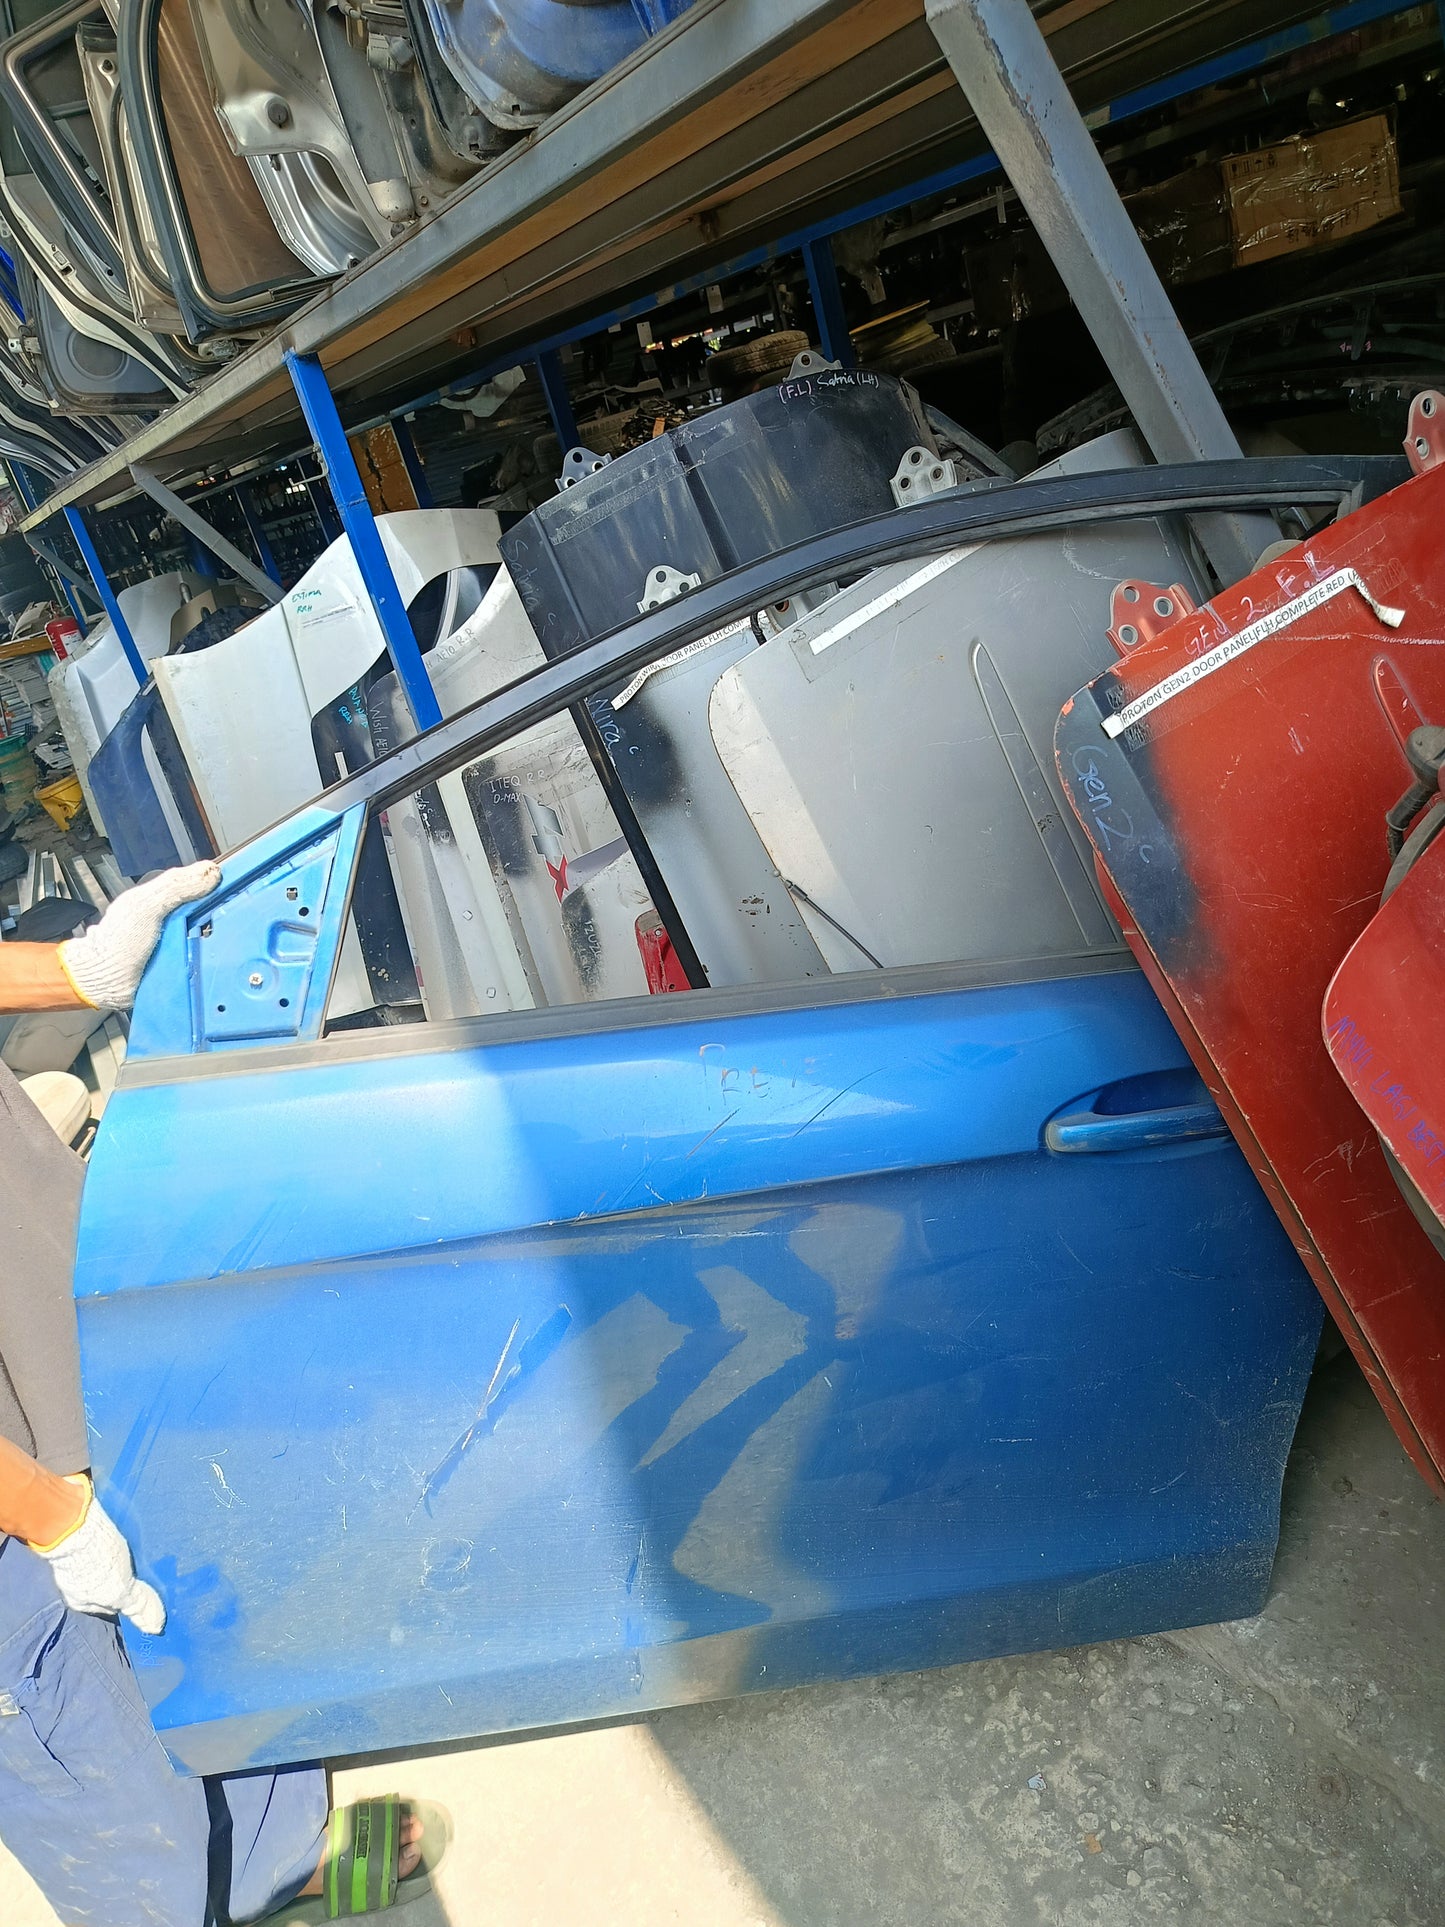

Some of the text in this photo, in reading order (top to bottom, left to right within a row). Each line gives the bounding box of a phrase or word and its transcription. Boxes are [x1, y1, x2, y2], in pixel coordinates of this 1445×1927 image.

[619, 677, 643, 703] PROTON
[683, 638, 709, 655] PANEL
[708, 630, 724, 643] FLH
[1121, 685, 1163, 725] PROTON
[1162, 671, 1192, 695] GEN2
[1192, 651, 1222, 677] DOOR
[1273, 586, 1327, 629] COMPLETE
[1325, 575, 1345, 594] RED
